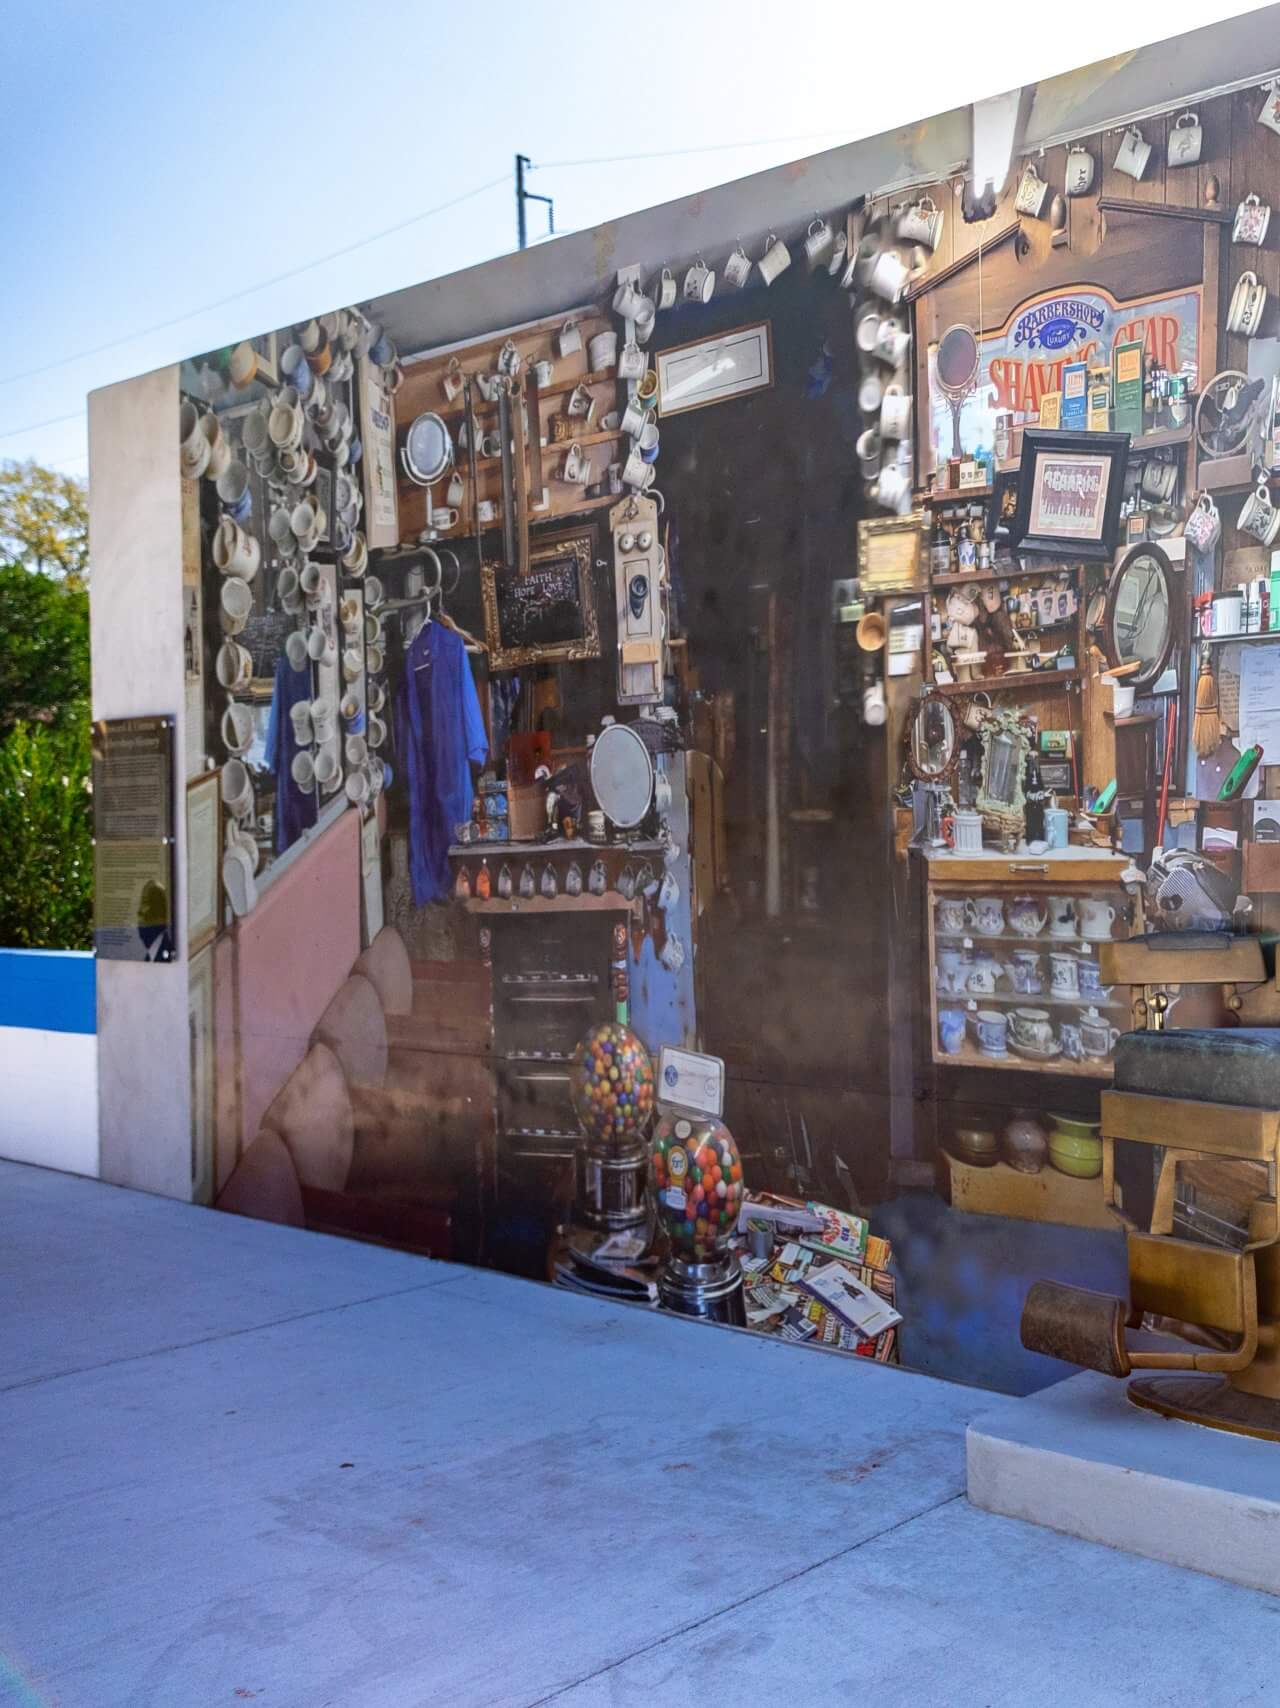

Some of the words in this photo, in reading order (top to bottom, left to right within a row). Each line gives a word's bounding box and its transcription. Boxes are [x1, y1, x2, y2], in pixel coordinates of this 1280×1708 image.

[1015, 300, 1104, 347] BARBERSHOP
[524, 572, 552, 586] FAITH
[514, 586, 535, 598] HOPE
[543, 582, 563, 593] LOVE
